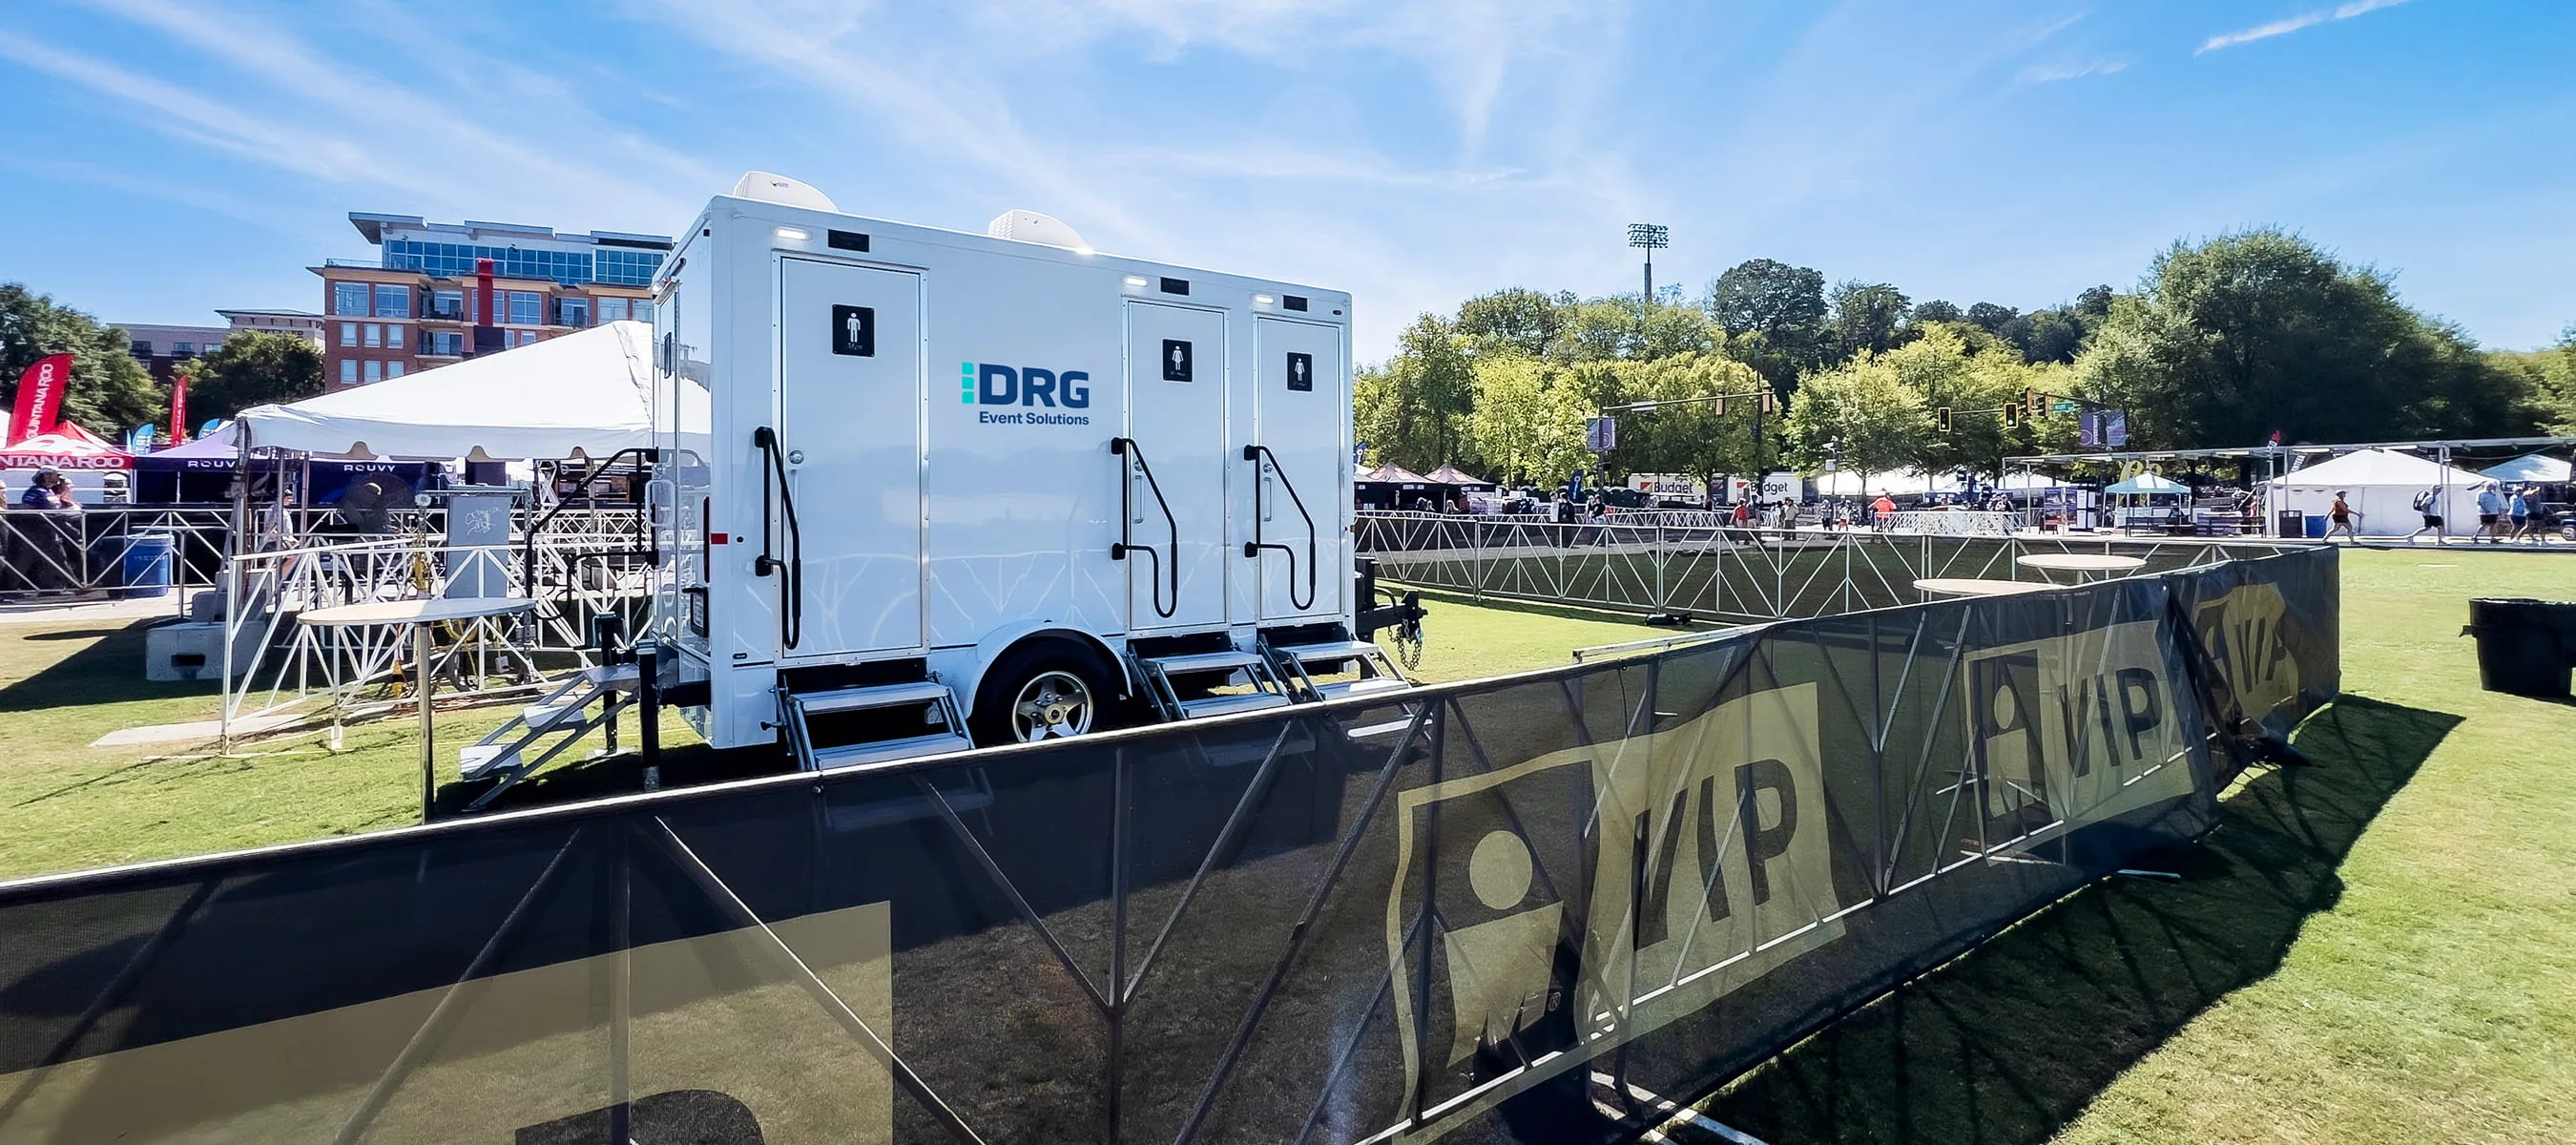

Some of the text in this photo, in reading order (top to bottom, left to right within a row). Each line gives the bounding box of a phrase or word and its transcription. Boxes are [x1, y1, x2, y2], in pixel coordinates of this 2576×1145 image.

[979, 364, 1090, 408] DRG
[979, 411, 1090, 426] Event Solutions
[1653, 482, 1693, 494] Budget
[1751, 482, 1788, 493] Bdget
[2058, 668, 2163, 778] VIP
[1631, 759, 1797, 952] VIP
